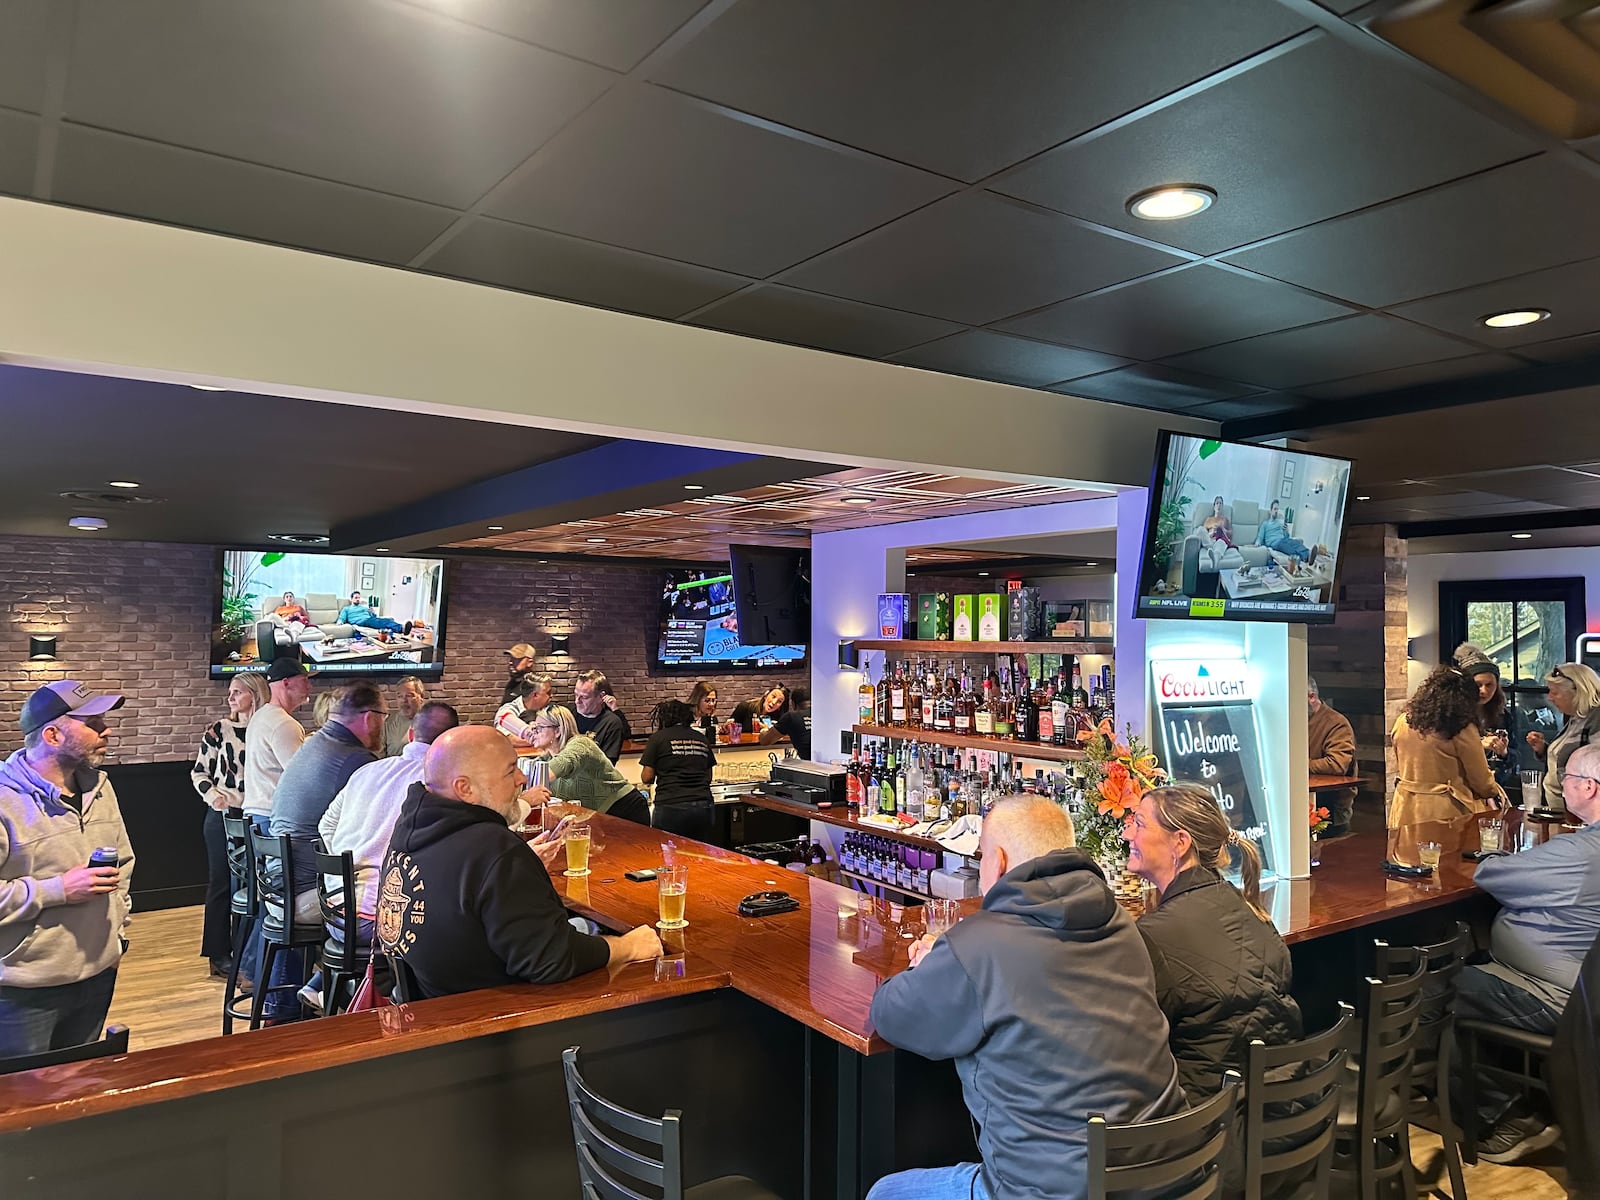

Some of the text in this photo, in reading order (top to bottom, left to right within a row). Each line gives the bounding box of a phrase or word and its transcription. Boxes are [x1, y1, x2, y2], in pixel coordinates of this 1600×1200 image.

[1159, 673, 1245, 697] Coors LIGHT
[1171, 719, 1241, 756] Welcome
[1200, 759, 1217, 778] to
[413, 901, 425, 911] 44
[410, 915, 424, 924] YOU
